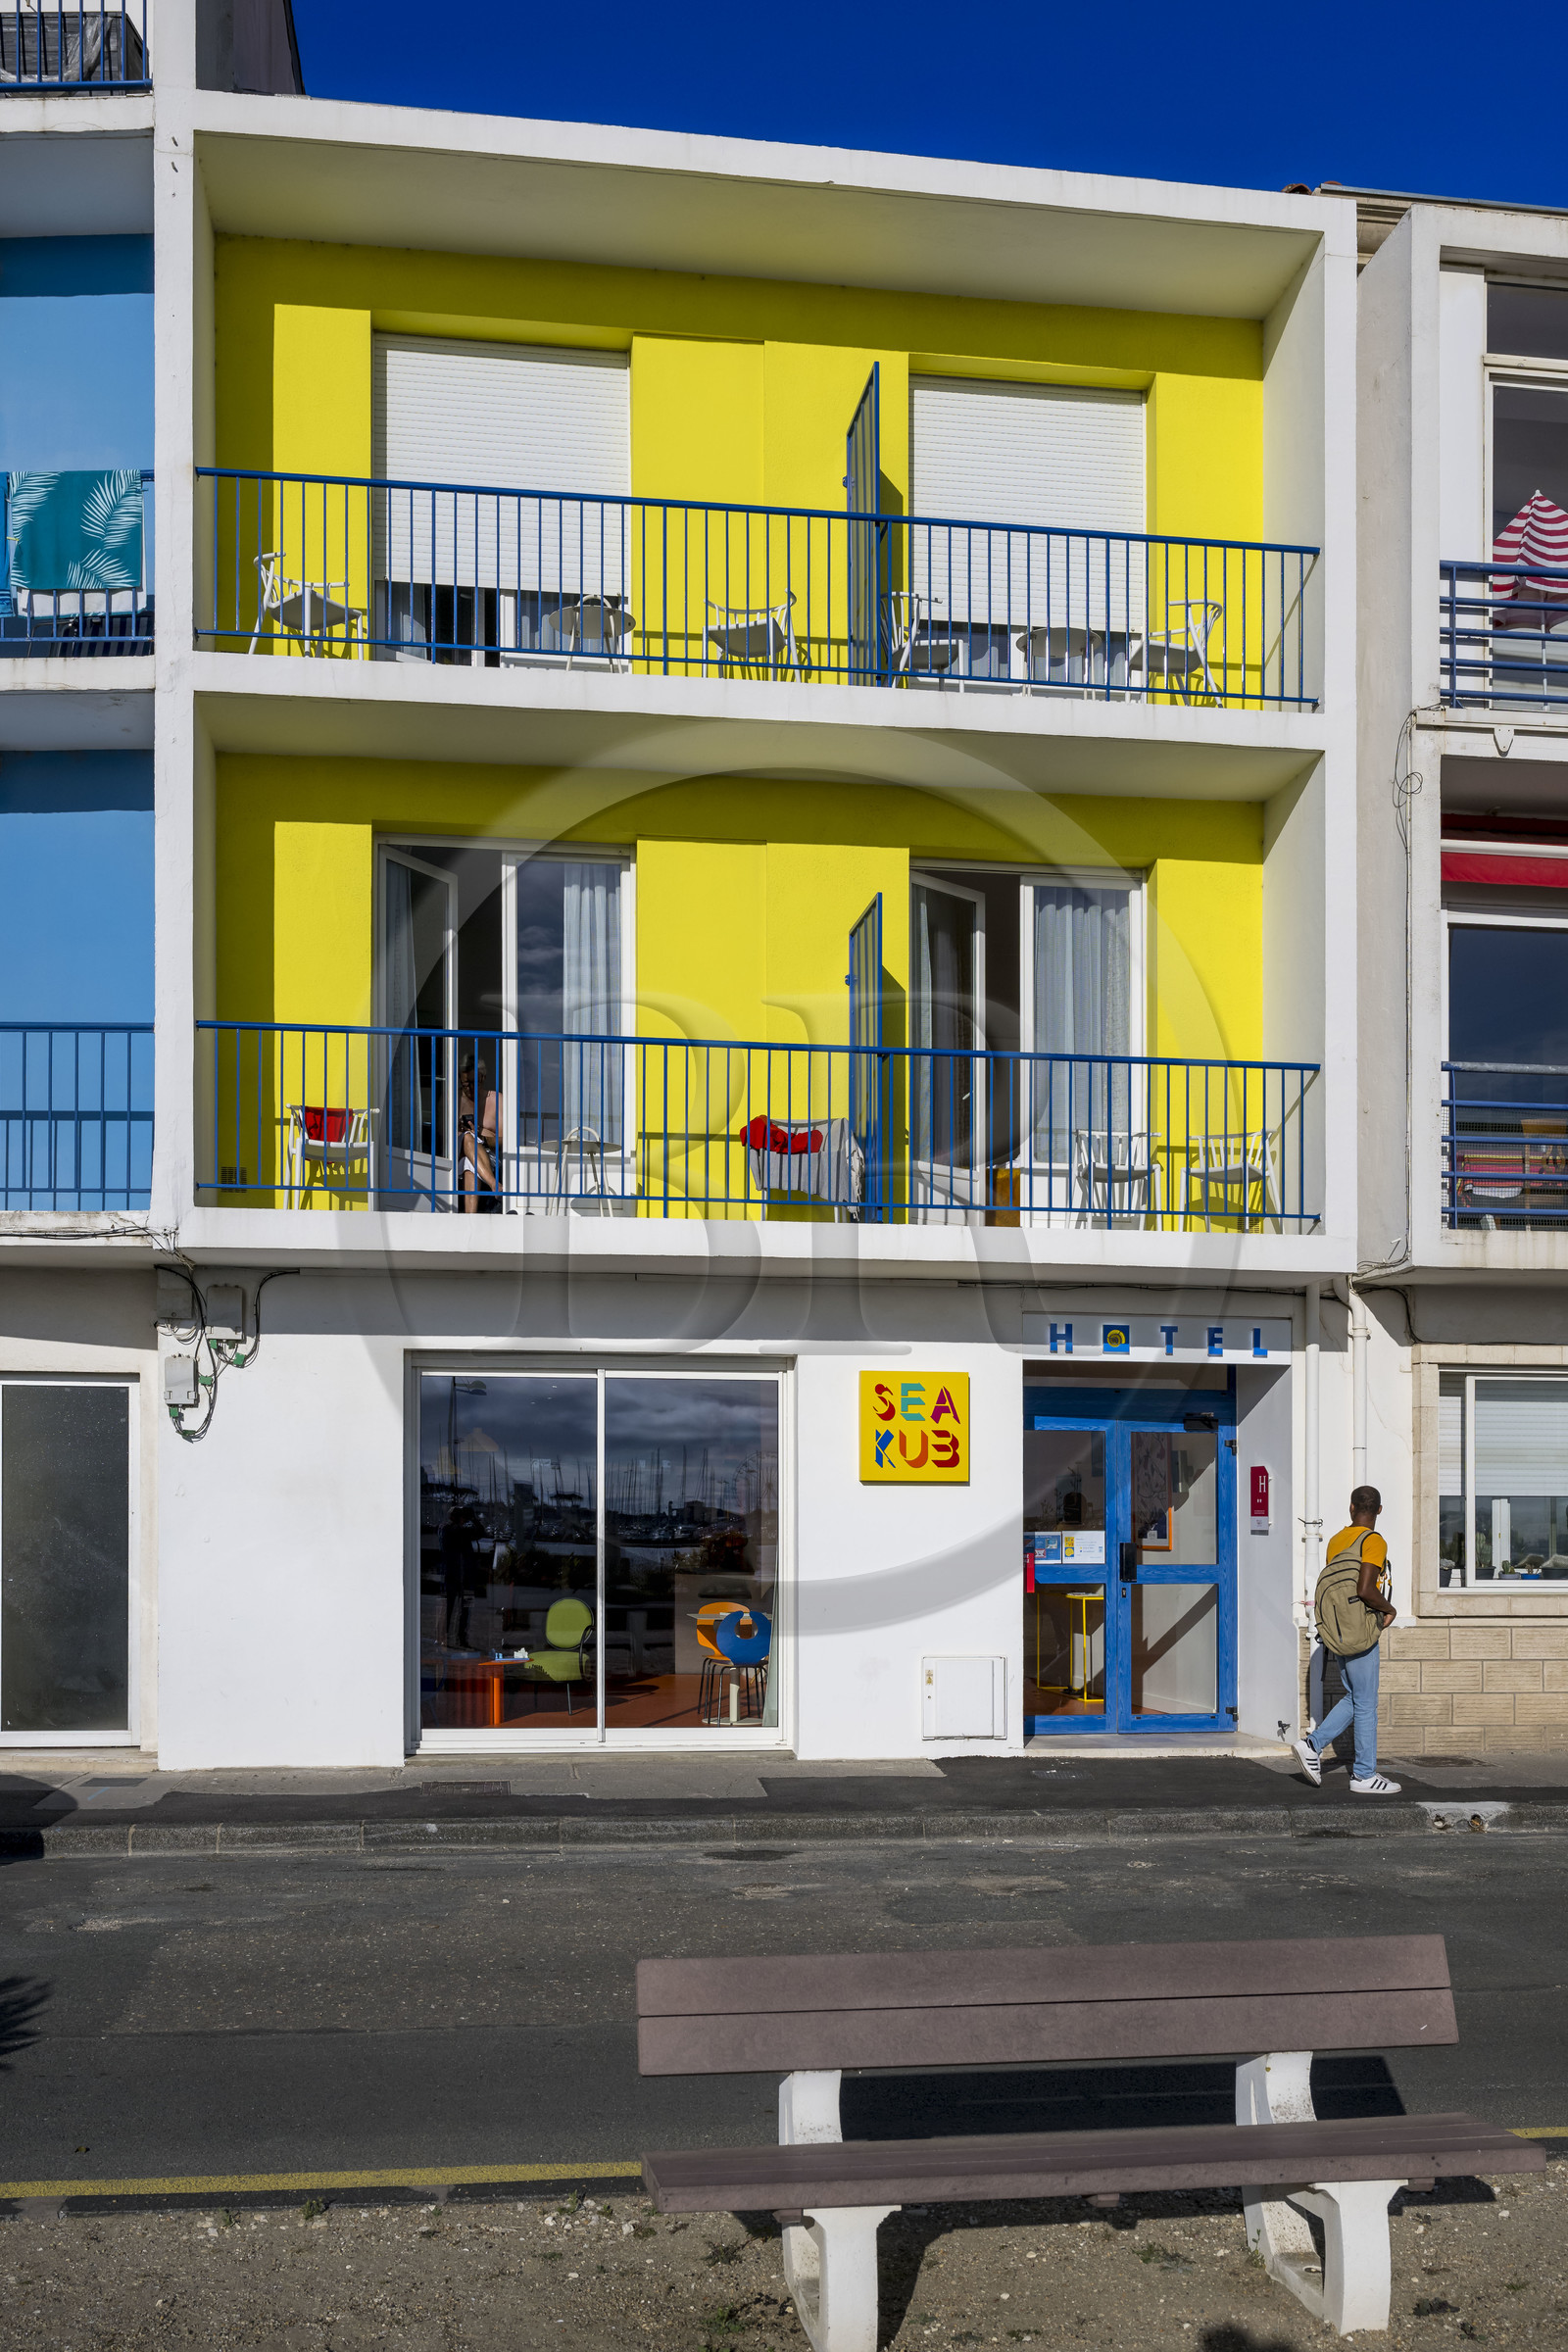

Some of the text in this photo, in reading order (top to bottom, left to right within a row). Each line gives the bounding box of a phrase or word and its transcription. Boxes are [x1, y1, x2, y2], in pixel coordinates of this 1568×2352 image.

[1049, 1323, 1268, 1358] HOTEL
[872, 1382, 961, 1425] SEA
[874, 1429, 961, 1469] KUB
[1258, 1475, 1267, 1494] H
